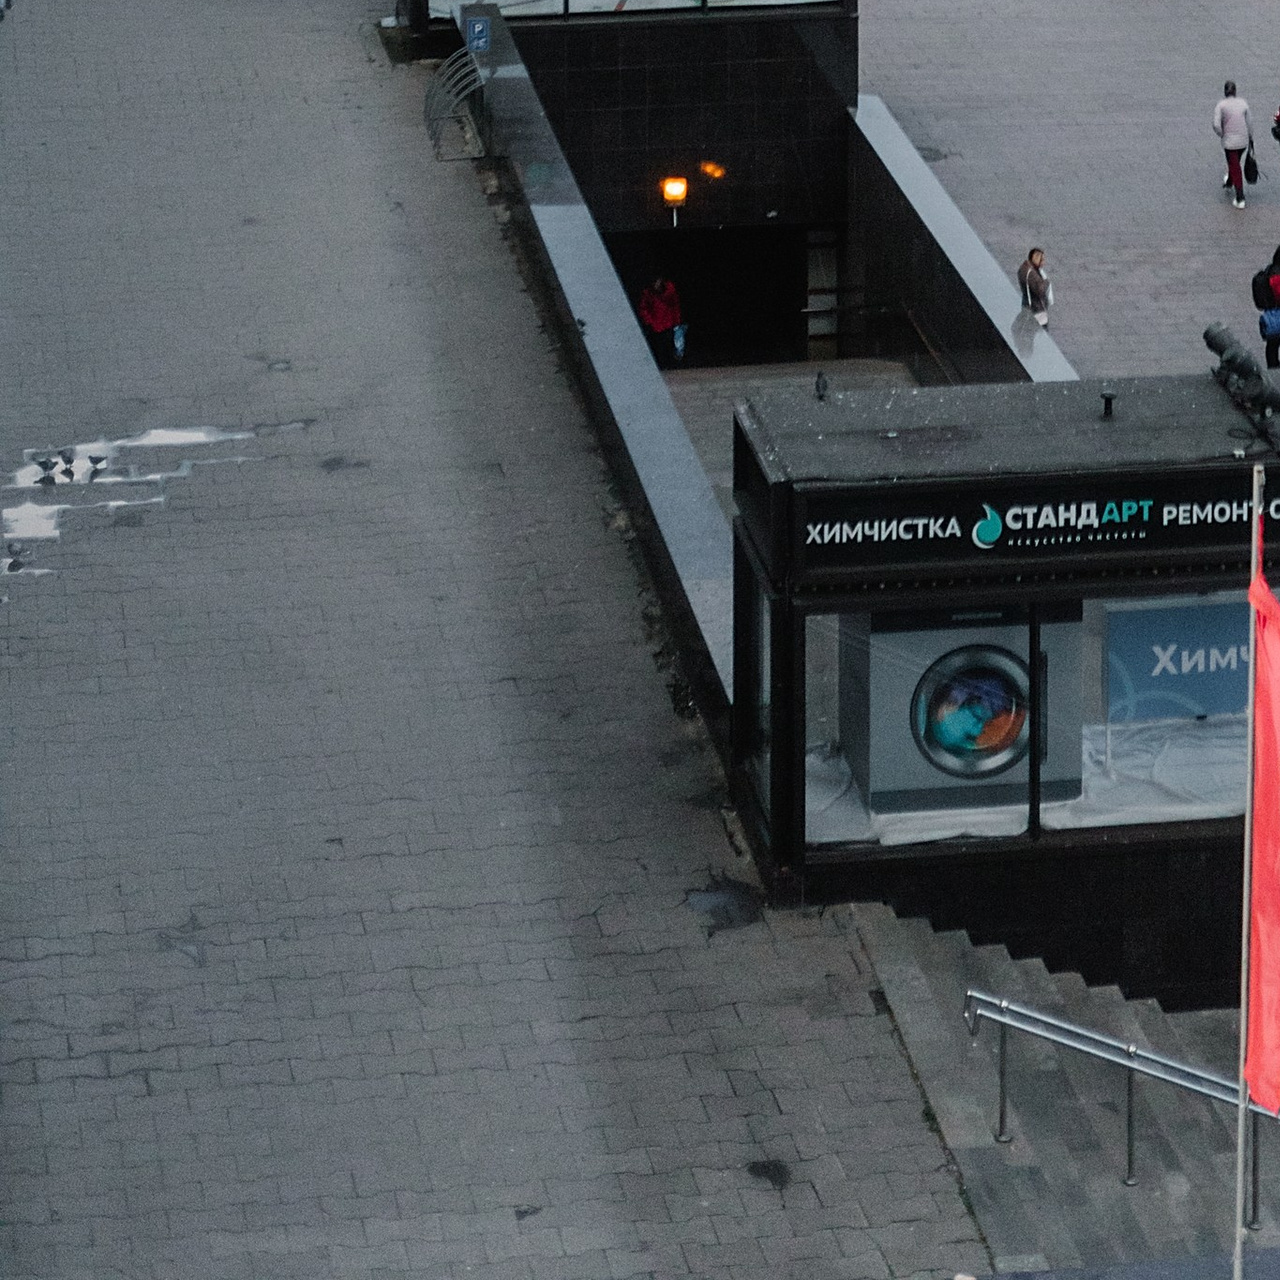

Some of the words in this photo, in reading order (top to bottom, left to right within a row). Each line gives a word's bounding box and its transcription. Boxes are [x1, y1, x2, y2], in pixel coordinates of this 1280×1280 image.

[1005, 500, 1154, 531] СТАНДАРТ
[1162, 500, 1254, 527] РЕМОН
[805, 515, 962, 545] ХИМЧИСТКА
[1007, 536, 1081, 547] искусство
[1087, 532, 1147, 543] чистоты
